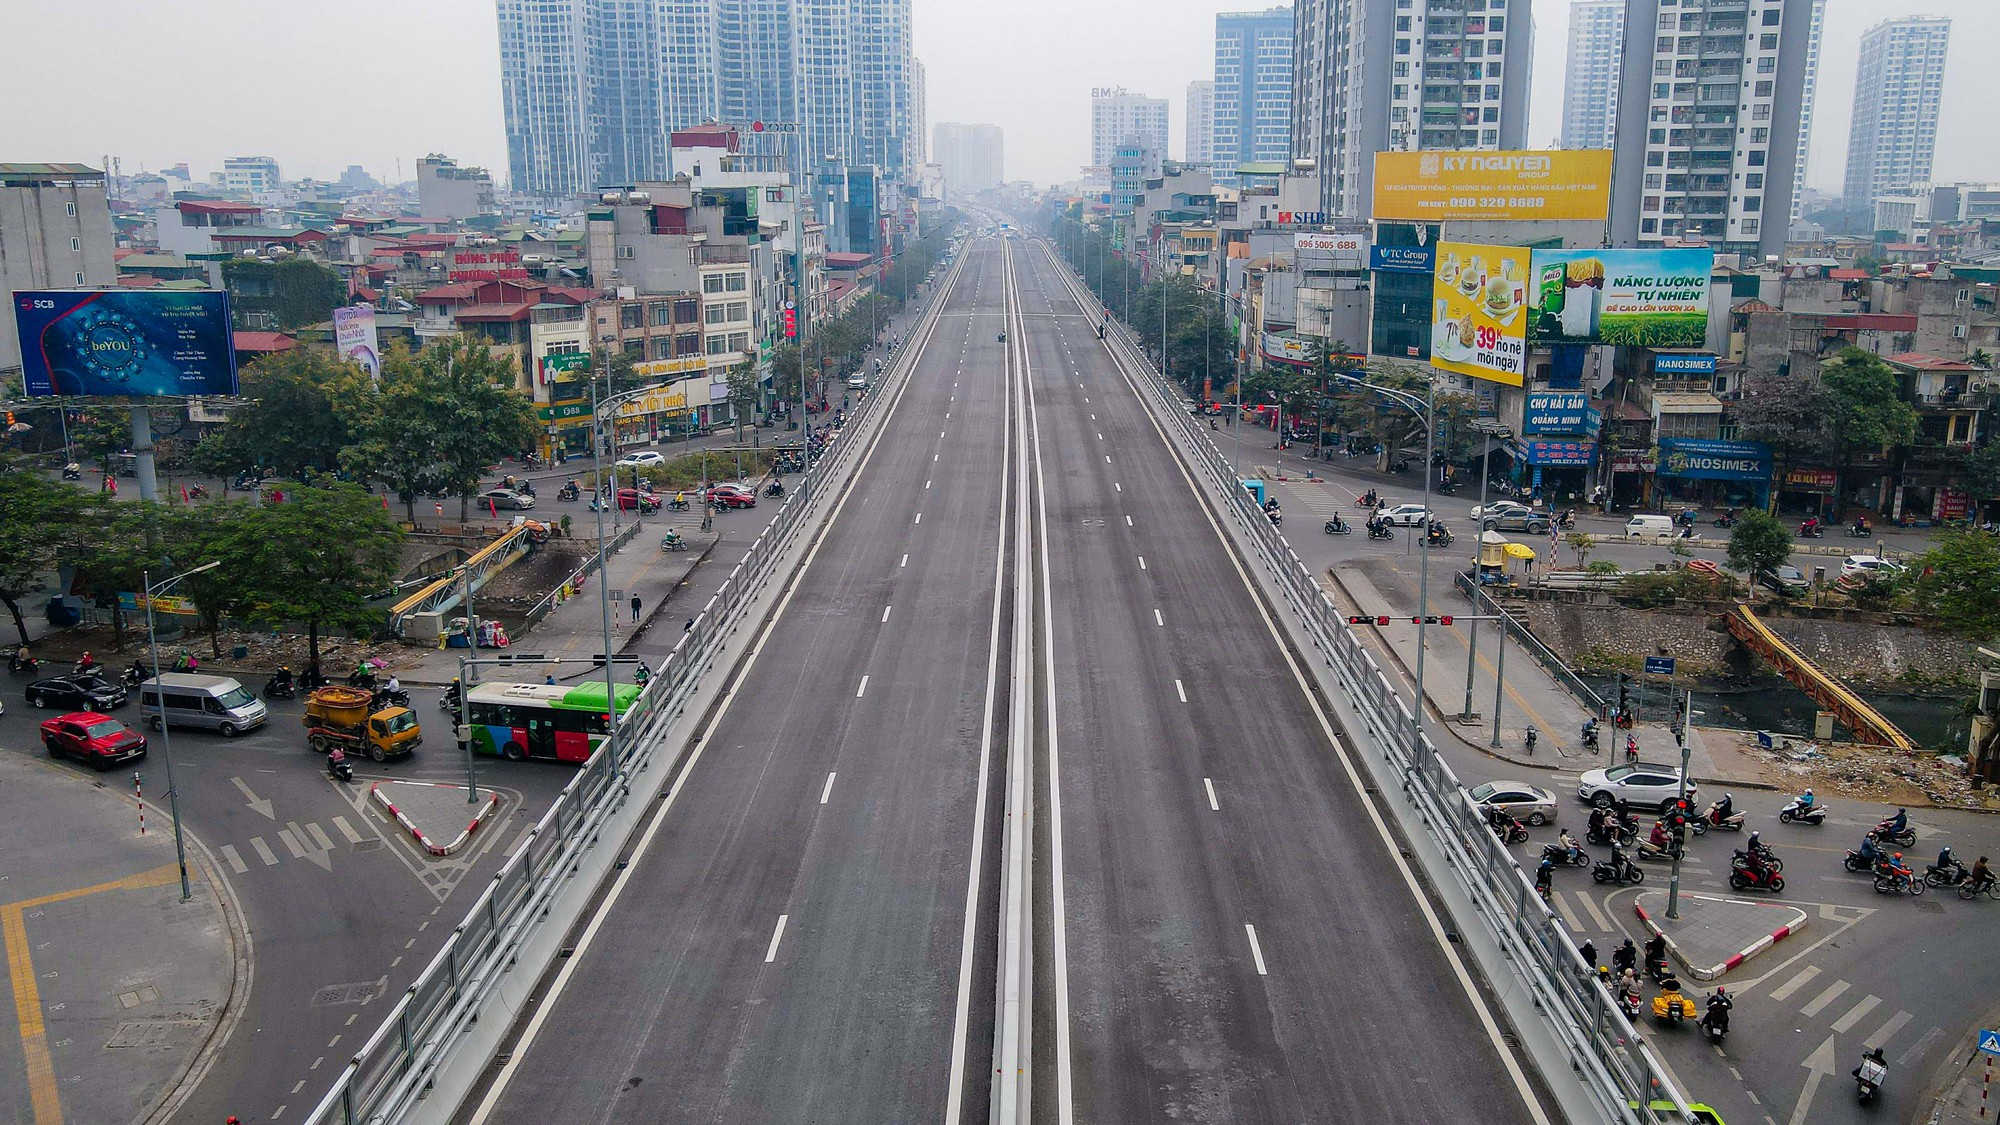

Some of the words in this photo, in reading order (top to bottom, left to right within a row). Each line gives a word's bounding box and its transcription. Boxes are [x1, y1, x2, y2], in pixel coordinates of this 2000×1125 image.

[1450, 197, 1476, 208] 090
[1480, 197, 1505, 208] 329
[1294, 212, 1325, 224] SHB
[1298, 240, 1313, 248] 096
[1314, 241, 1334, 249] 5005
[1337, 241, 1357, 250] 688
[1391, 249, 1402, 258] TC
[1403, 249, 1429, 262] Group
[1543, 272, 1560, 281] MILO
[1613, 275, 1654, 287] NĂNG
[1656, 275, 1705, 290] LƯỢNG
[1637, 290, 1657, 303] TỰ
[34, 300, 55, 309] SCB
[91, 341, 130, 351] beYOU
[1496, 341, 1508, 353] no
[1509, 341, 1522, 355] nê
[1495, 355, 1519, 372] ngày
[1658, 360, 1712, 369] HANOSIMEX
[1530, 397, 1549, 412] CHỢ
[1550, 395, 1565, 409] HẢI
[1567, 395, 1584, 409] SẢN
[563, 407, 580, 416] F88
[1531, 413, 1559, 425] QUẢNG
[1561, 416, 1581, 425] NINH
[1792, 474, 1802, 483] XE
